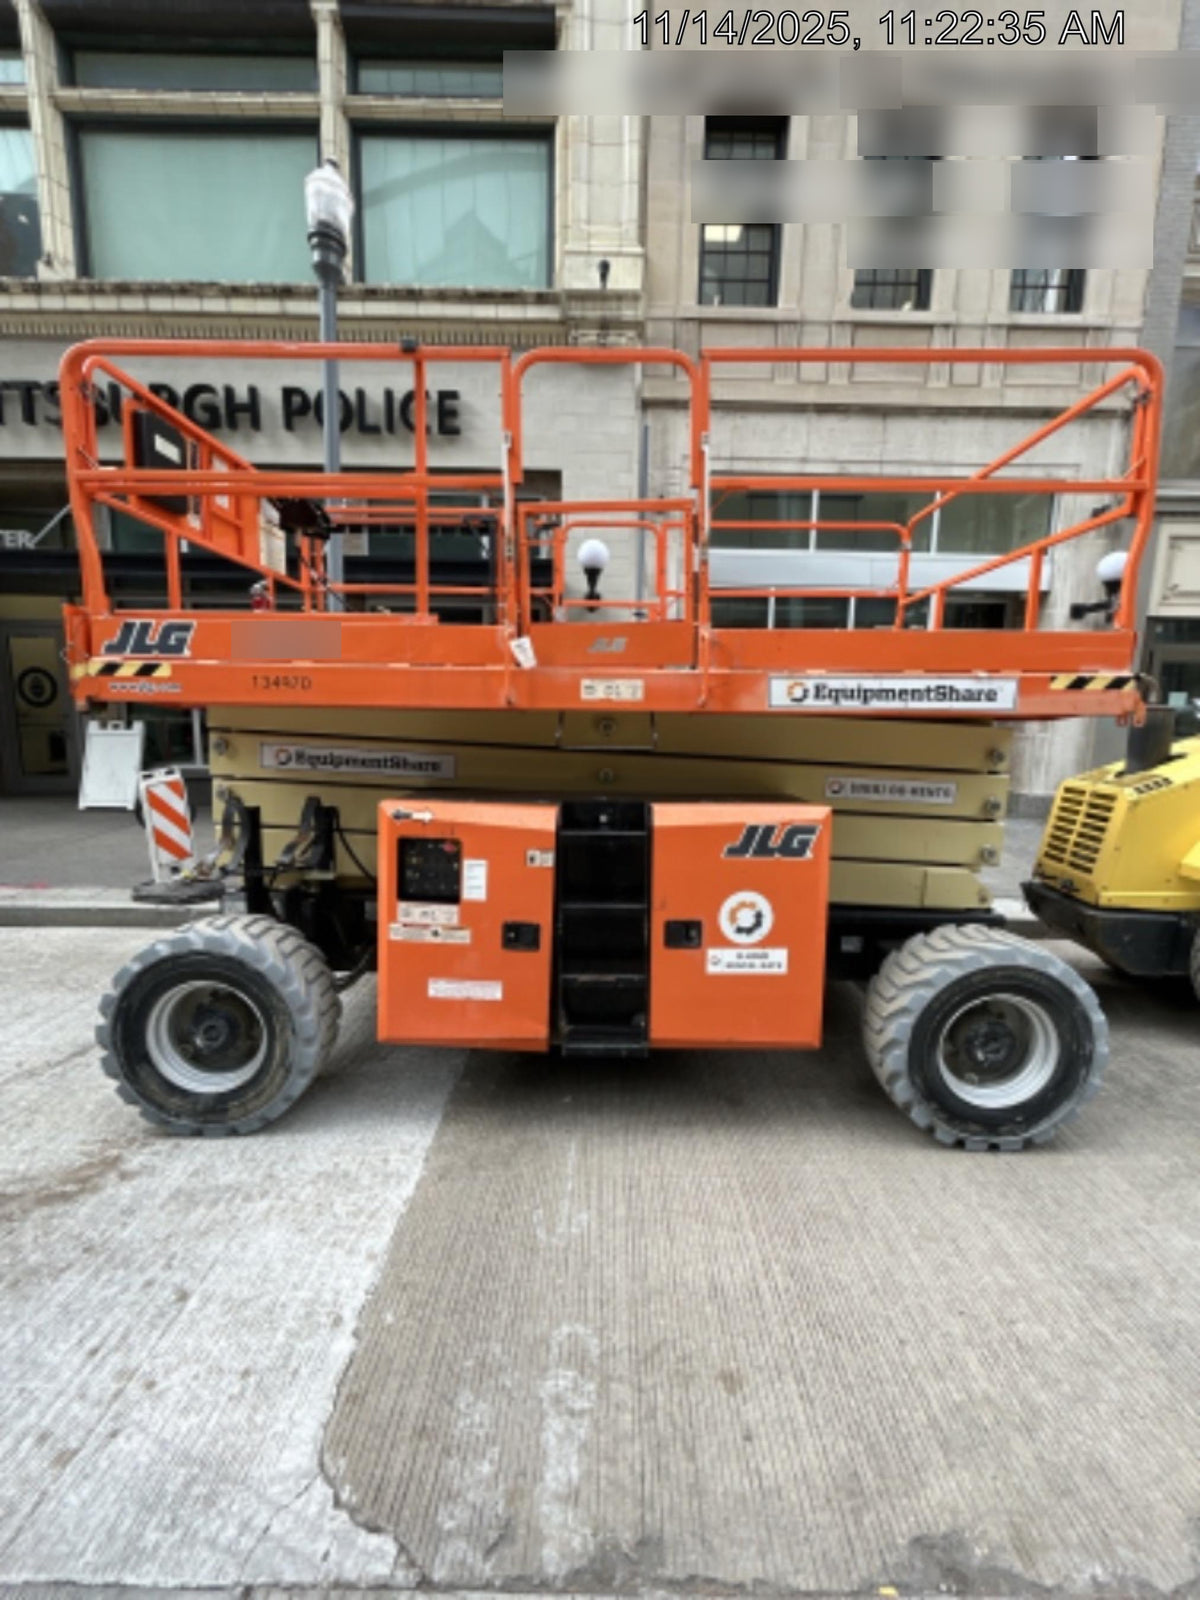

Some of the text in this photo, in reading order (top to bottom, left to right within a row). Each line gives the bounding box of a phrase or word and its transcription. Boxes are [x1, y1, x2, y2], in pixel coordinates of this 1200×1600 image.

[282, 386, 461, 436] POLICE
[102, 618, 197, 657] JLG
[813, 683, 998, 705] EquipmentShare
[295, 750, 442, 772] EquipmentShare
[720, 823, 822, 860] JLG
